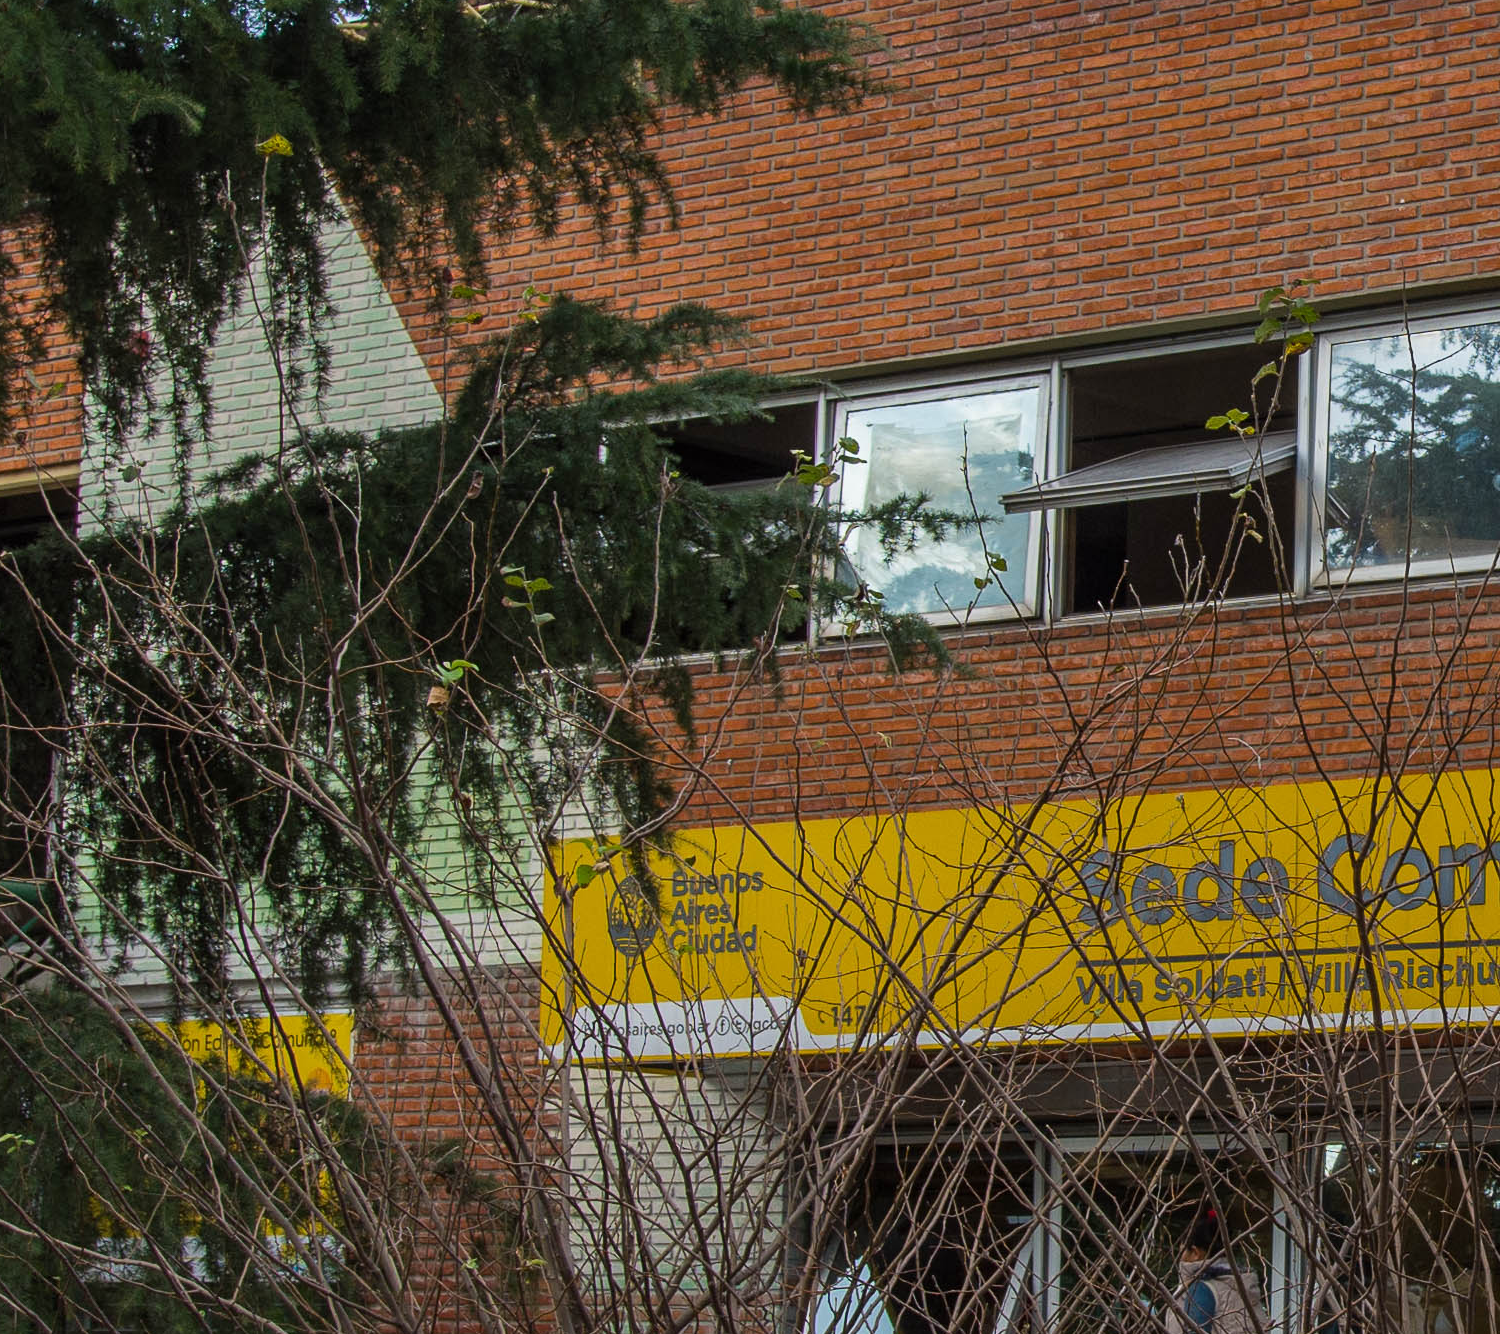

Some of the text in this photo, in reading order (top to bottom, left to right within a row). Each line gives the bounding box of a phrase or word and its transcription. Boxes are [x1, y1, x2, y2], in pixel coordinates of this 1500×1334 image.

[671, 870, 764, 897] Buenos
[1077, 839, 1290, 928] Sede
[669, 898, 732, 926] Aires
[669, 923, 758, 956] Ciudad
[1076, 971, 1144, 1006] Villa
[1154, 965, 1267, 1003] Soldati
